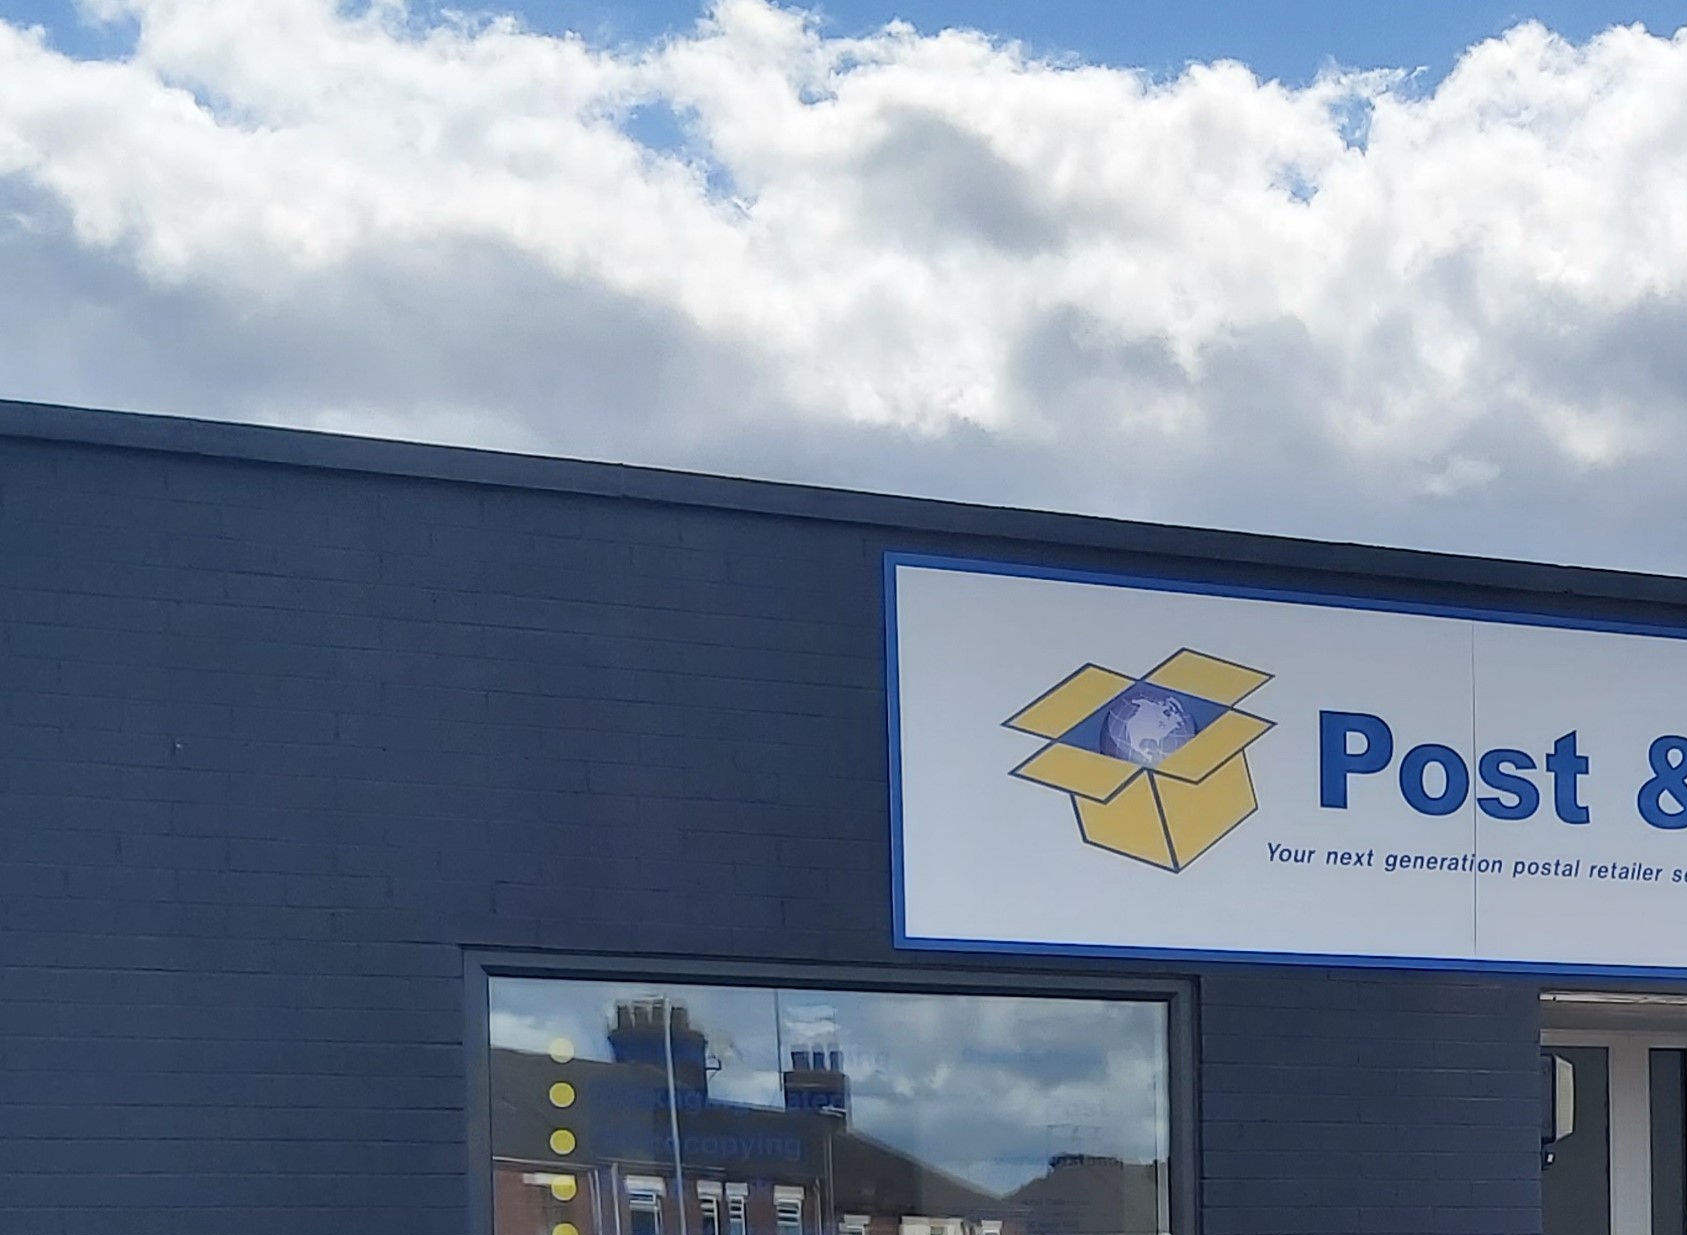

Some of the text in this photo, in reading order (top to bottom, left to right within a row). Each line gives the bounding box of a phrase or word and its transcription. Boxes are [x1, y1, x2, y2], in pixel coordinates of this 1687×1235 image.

[1318, 709, 1591, 826] Post
[1266, 842, 1316, 865] Your
[1325, 849, 1374, 868] next
[1384, 850, 1503, 875] generation
[1512, 859, 1581, 878] postal
[1588, 861, 1663, 882] retailer
